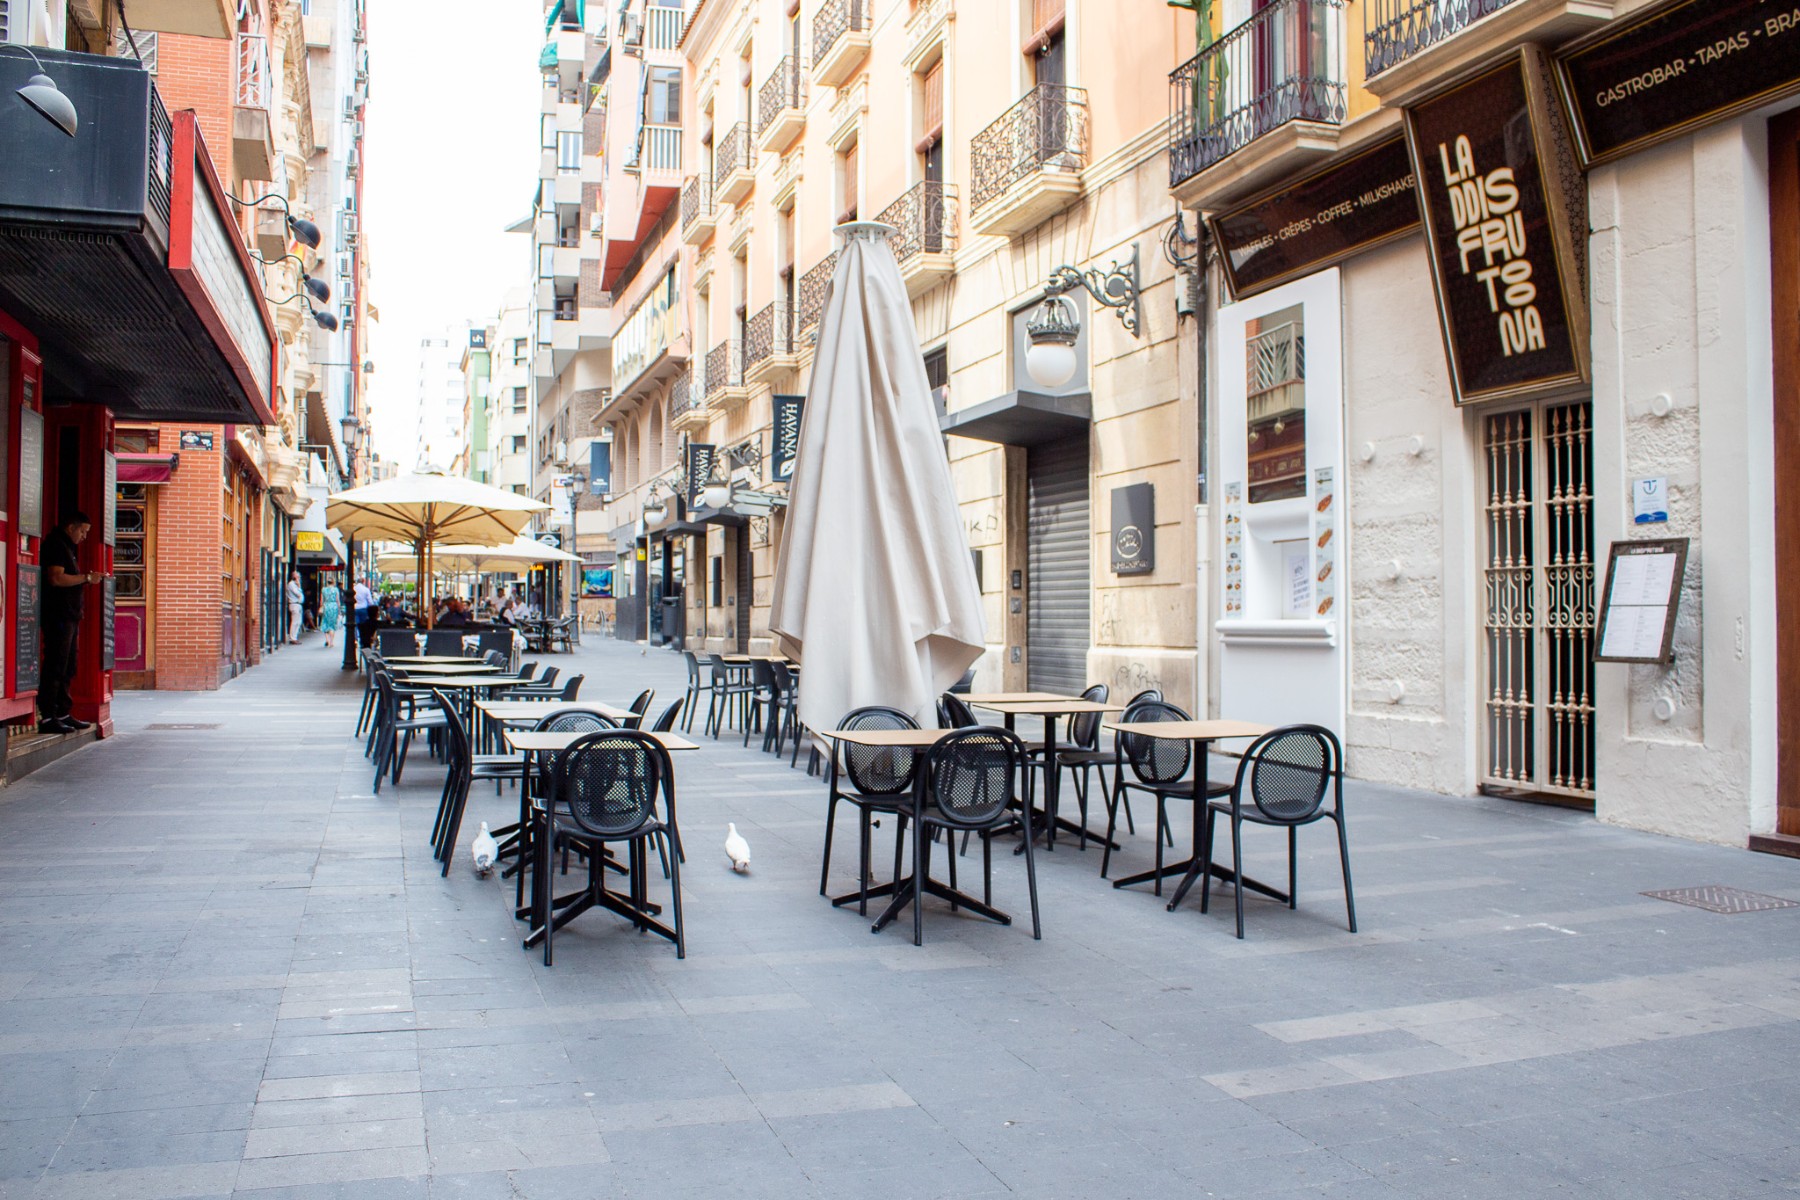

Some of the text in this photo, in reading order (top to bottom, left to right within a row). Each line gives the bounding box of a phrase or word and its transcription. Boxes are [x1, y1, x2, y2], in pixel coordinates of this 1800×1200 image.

[1596, 8, 1800, 107] GASTROBAR TAPAS BRA
[1439, 134, 1476, 187] LA
[1237, 174, 1416, 257] WAFFLES CRÊPES COFFEE MILKSHAKE
[784, 403, 798, 458] HAVANA
[697, 449, 709, 493] HAVANA
